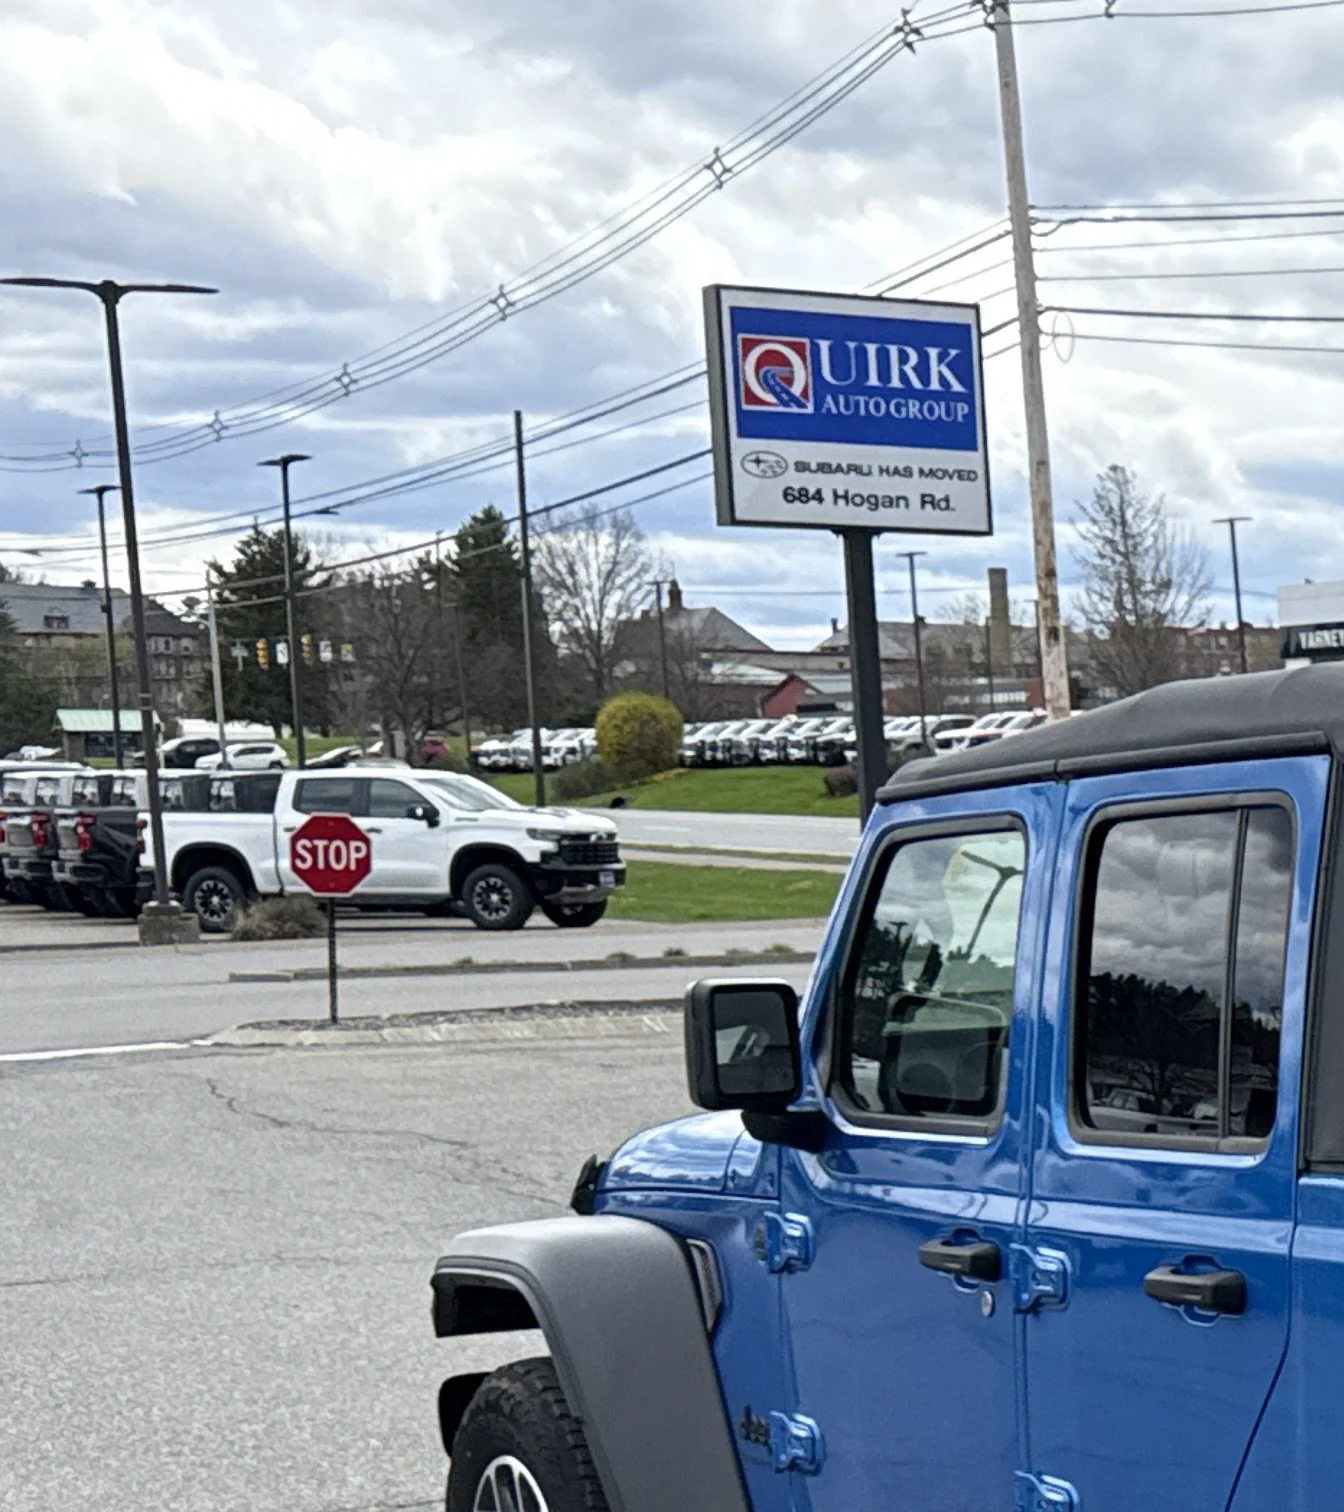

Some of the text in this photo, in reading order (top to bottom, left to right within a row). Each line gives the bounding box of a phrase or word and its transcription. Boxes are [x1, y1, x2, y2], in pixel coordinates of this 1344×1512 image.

[744, 339, 969, 410] QUIRK
[794, 460, 978, 482] SUBARU HAS MOVED
[782, 486, 825, 504] 684
[832, 488, 909, 511] Hogan
[294, 838, 368, 871] STOP
